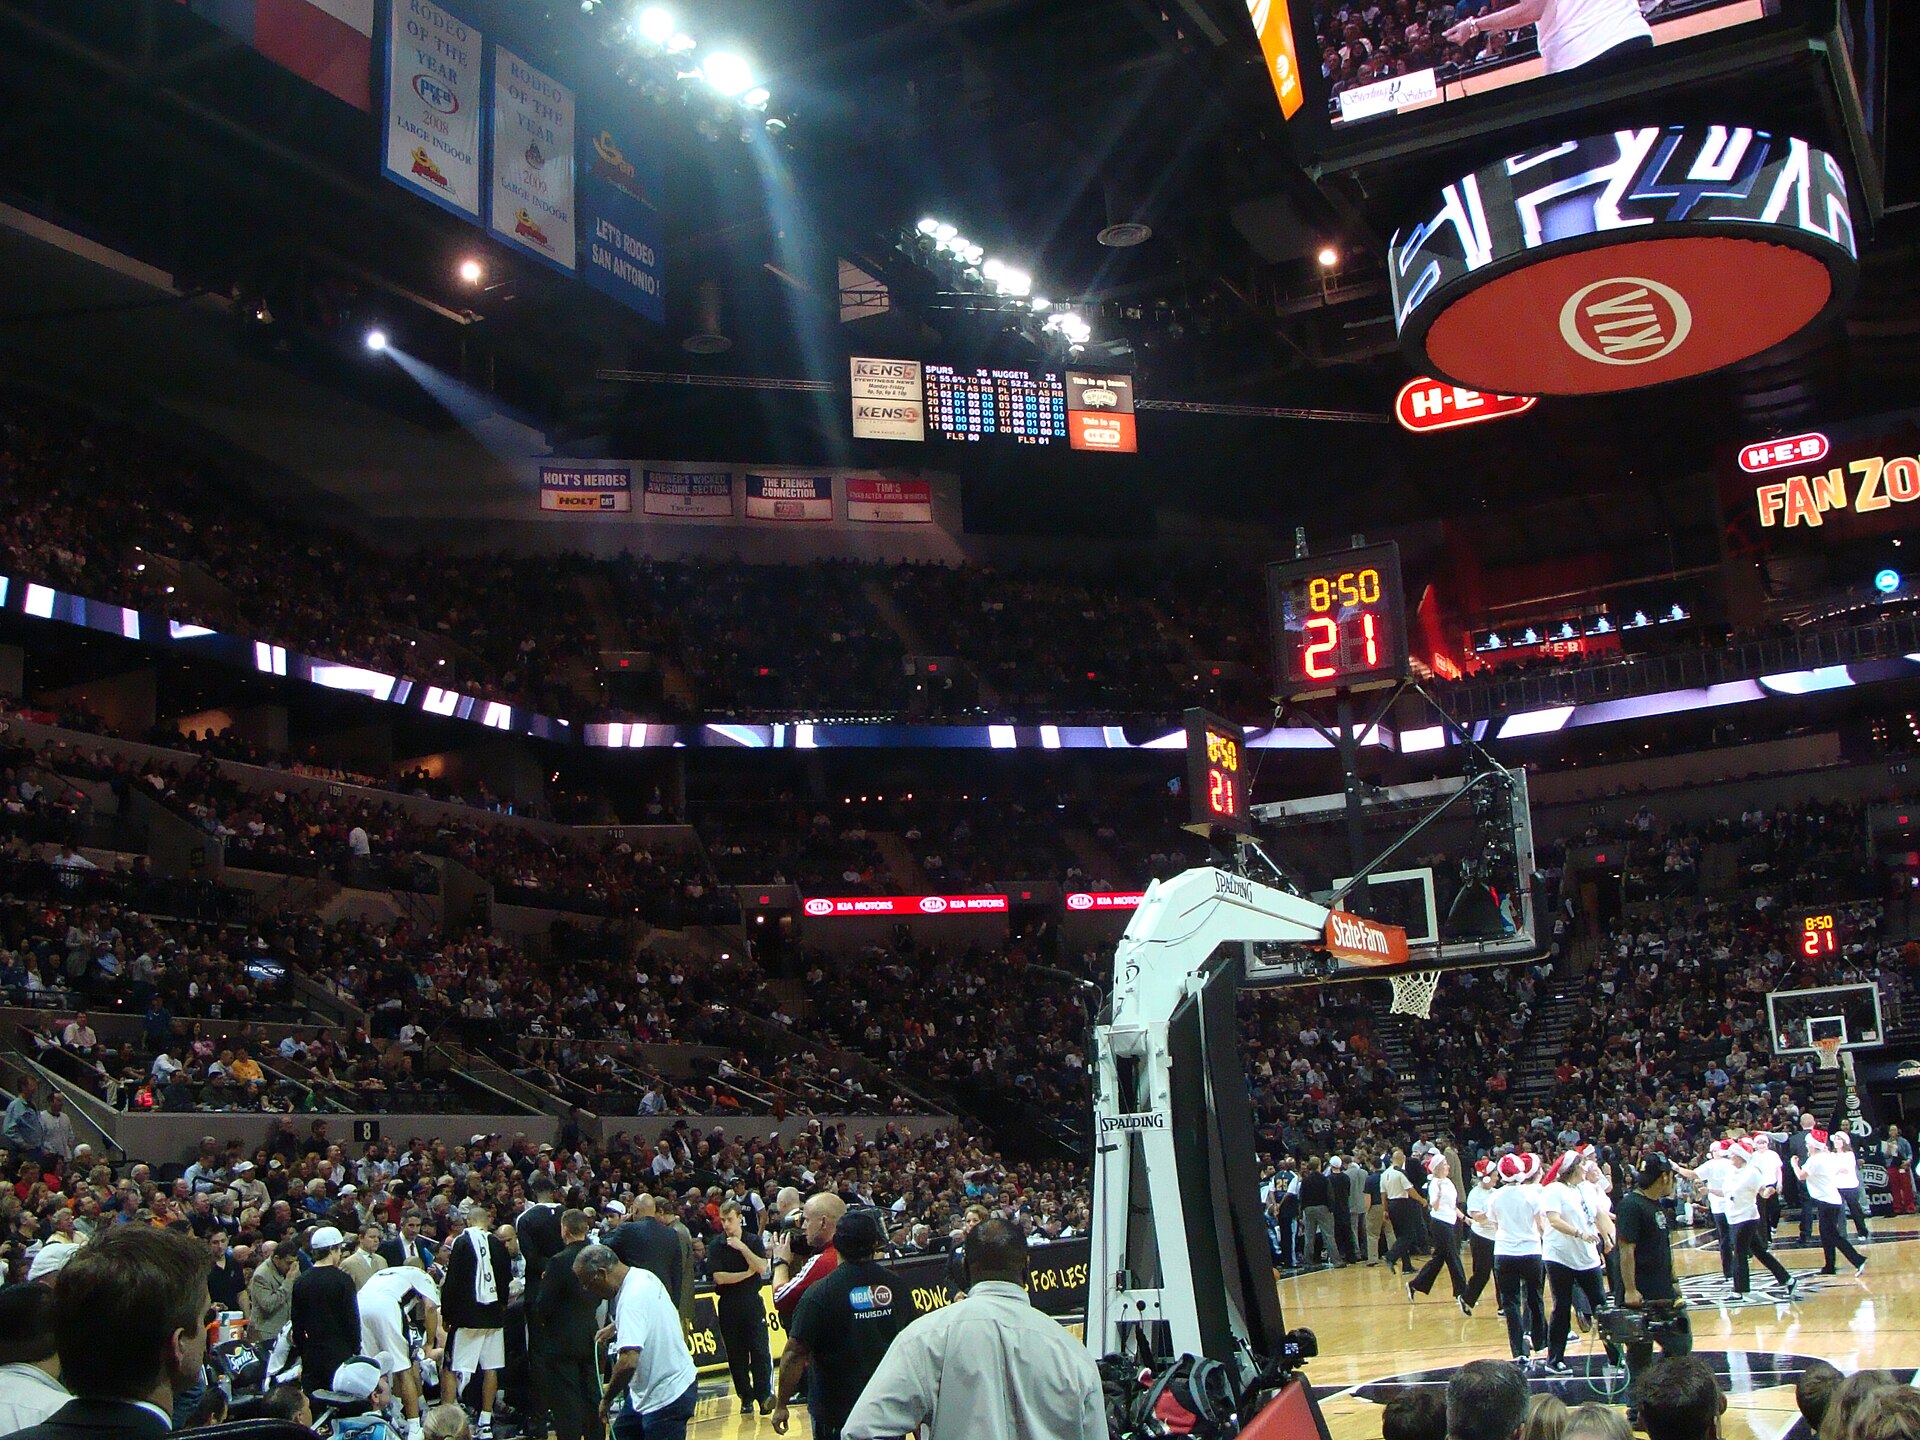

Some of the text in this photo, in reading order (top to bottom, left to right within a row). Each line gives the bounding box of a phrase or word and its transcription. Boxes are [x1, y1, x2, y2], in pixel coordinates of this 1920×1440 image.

[410, 0, 467, 43] RODEO
[407, 20, 468, 67] OF THE
[416, 48, 457, 84] YEAR
[511, 62, 561, 104] RODEO
[509, 85, 563, 128] OF THE
[1341, 86, 1434, 106] Sterling Silver
[423, 111, 449, 134] 2008
[517, 113, 554, 145] YEAR
[397, 115, 472, 165] LARGE INDOOR
[501, 177, 567, 223] LARGE INDOOR
[596, 217, 655, 267] LET'S RODEO
[592, 245, 612, 271] SAN
[1586, 288, 1667, 356] KIA
[926, 366, 953, 374] SPURS
[992, 370, 1028, 379] NUGGETS
[1087, 392, 1113, 401] SPURS
[1748, 437, 1822, 468] H-E-B
[544, 472, 627, 486] HOLT'S HEROES
[648, 484, 728, 494] AWESOME SECTION
[763, 478, 814, 488] THE FRENCH
[875, 483, 901, 493] TIM'S
[559, 496, 597, 505] HOLT
[762, 488, 816, 498] CONNECTION
[1757, 456, 1920, 528] FAN ZO
[1309, 569, 1380, 612] 8:50
[1304, 614, 1377, 679] 21
[1210, 770, 1234, 815] 21
[1215, 870, 1253, 903] SPALDING
[836, 902, 853, 911] KIA
[854, 900, 894, 910] MOTORS
[950, 900, 966, 908] KIA
[968, 898, 1004, 908] MOTORS
[1097, 897, 1112, 905] KIA
[1804, 915, 1833, 931] 8:50
[1804, 931, 1833, 954] 21
[364, 1122, 372, 1140] 8
[1101, 1114, 1164, 1132] SPALDING
[1276, 1178, 1288, 1190] 25
[1030, 1268, 1059, 1292] FOR
[852, 1292, 889, 1304] NBA TNT
[854, 1308, 892, 1320] THURSDAY
[231, 1350, 252, 1370] Sprite
